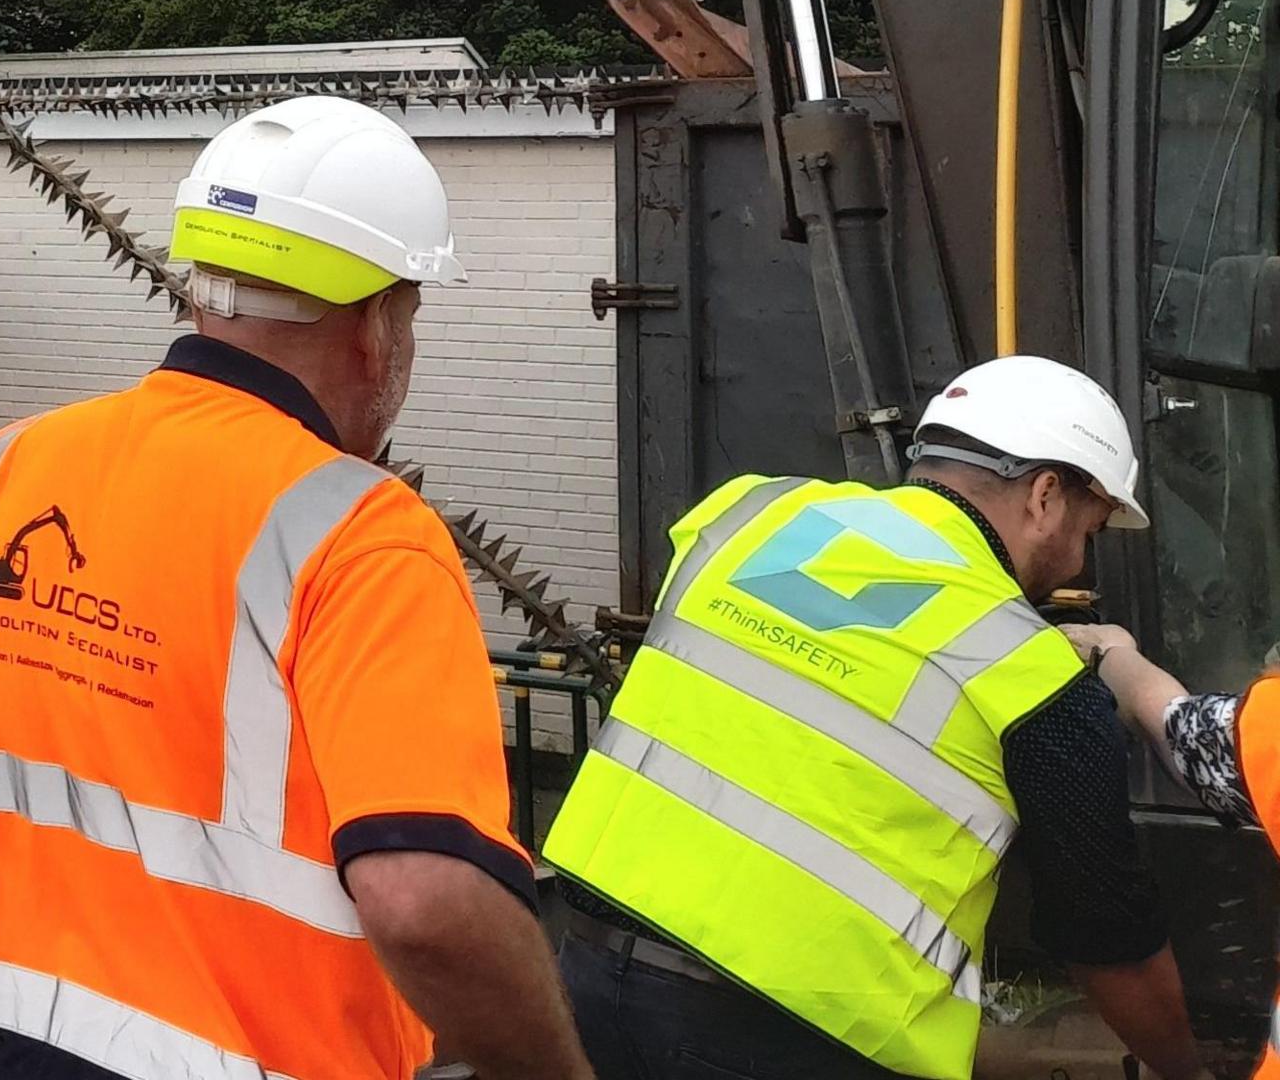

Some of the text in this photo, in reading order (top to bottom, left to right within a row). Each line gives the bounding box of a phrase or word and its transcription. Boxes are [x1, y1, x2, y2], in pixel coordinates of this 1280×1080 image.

[66, 631, 160, 676] SECIALIST
[124, 624, 162, 646] LTD.
[706, 596, 858, 680] #ThinkSAFETY
